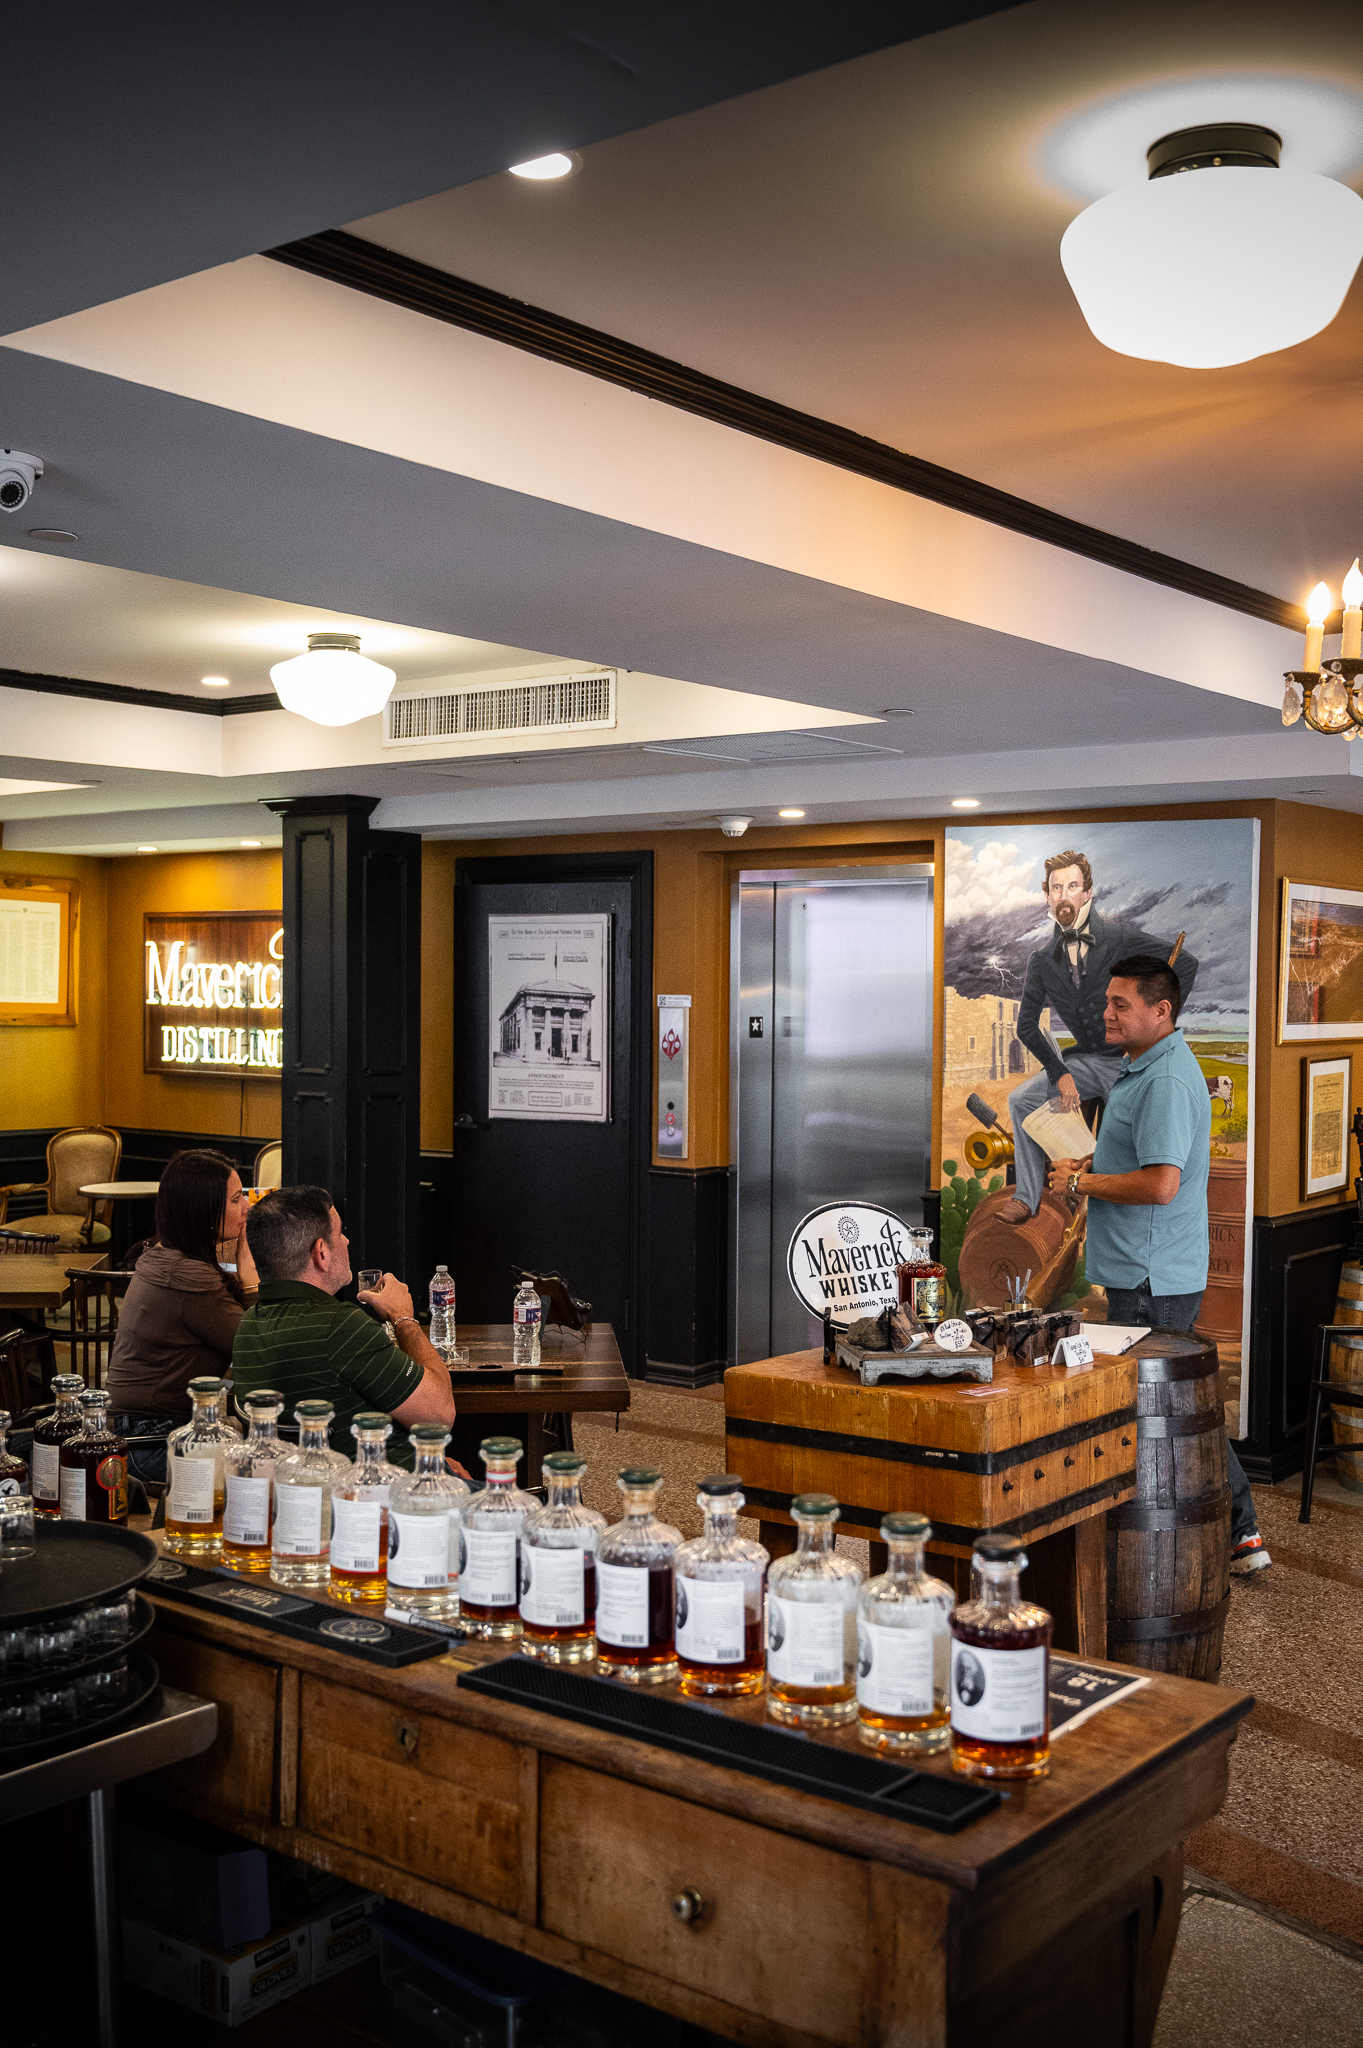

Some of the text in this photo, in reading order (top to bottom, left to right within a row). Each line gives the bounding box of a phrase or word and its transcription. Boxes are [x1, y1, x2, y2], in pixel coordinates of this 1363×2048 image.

[145, 928, 284, 1009] Maveric
[528, 1072, 565, 1080] ANNOUNCEMENT
[801, 1218, 908, 1278] Maverick
[818, 1269, 899, 1299] WHISKE
[833, 1296, 898, 1313] San Antonio, Texa
[255, 1939, 290, 1962] KIRKLAND
[328, 1931, 368, 1956] GLOVES
[253, 1964, 295, 1993] GLOVES
